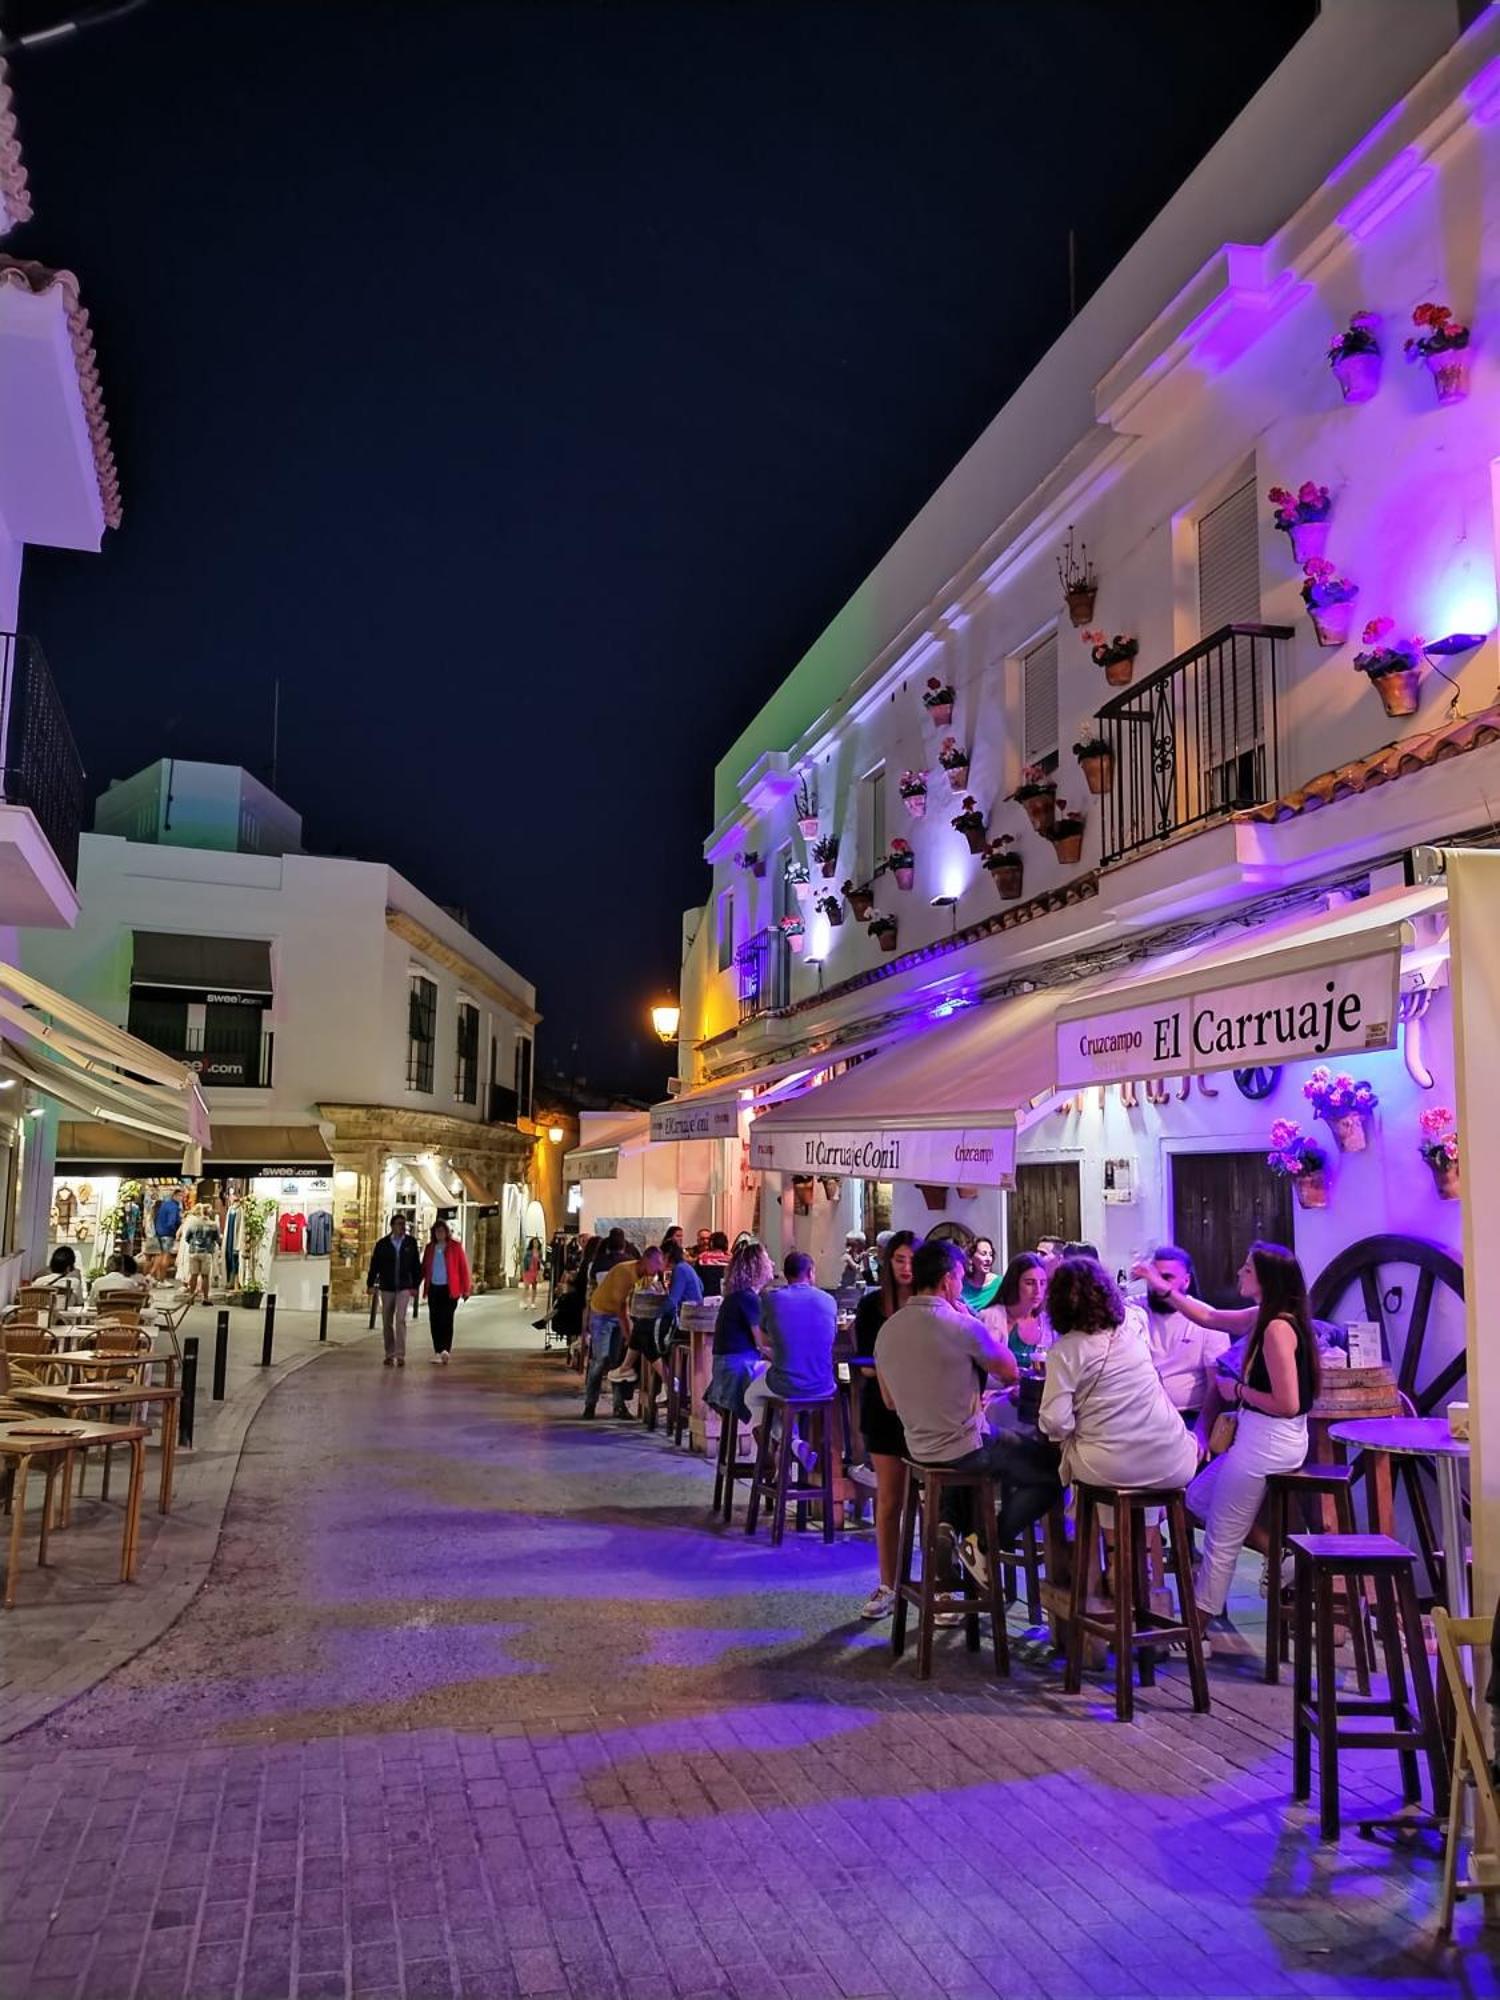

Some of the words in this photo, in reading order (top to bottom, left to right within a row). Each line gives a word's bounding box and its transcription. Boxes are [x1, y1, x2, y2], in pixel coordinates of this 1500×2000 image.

[1079, 1029, 1142, 1056] Cruzcampo
[1153, 1013, 1181, 1061] El
[1192, 981, 1361, 1053] Carruaje
[805, 1141, 815, 1164] El
[815, 1141, 861, 1174] Carruaje
[863, 1141, 900, 1169] Conil
